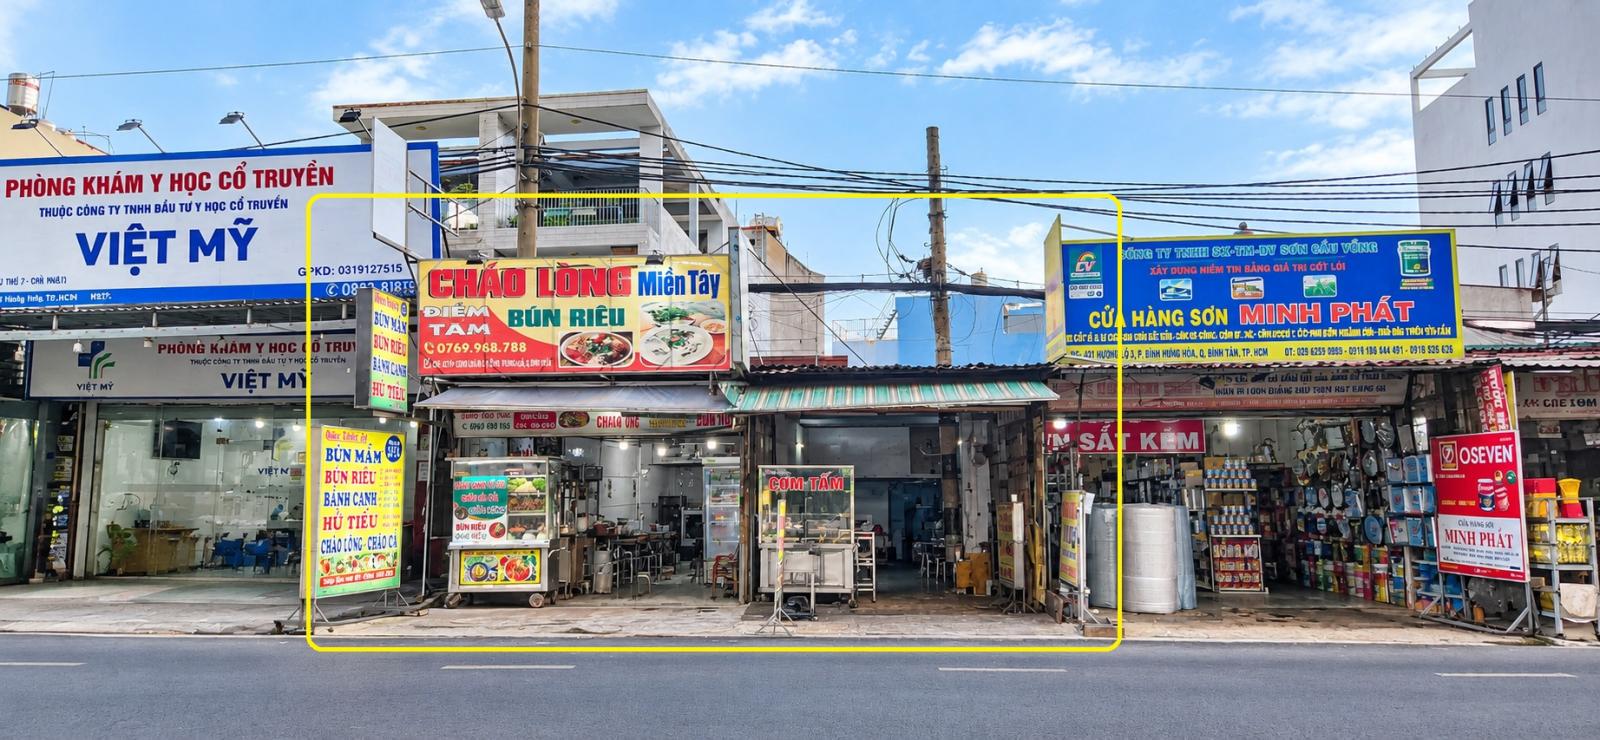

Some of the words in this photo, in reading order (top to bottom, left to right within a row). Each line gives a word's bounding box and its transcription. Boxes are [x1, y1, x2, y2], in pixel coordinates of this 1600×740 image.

[5, 174, 76, 198] PHÒNG
[83, 171, 143, 195] KHÁM
[151, 174, 163, 192] Y
[169, 172, 211, 196] HỌC
[219, 161, 247, 190] CỔ
[253, 160, 334, 189] TRUYỀN
[109, 205, 121, 215] TY
[125, 203, 151, 214] TNHH
[195, 202, 202, 212] Y
[205, 202, 226, 214] HỌC
[76, 223, 176, 276] VIỆT
[189, 217, 259, 262] MỸ
[1155, 247, 1172, 259] TY
[1174, 246, 1209, 258] TNHH
[338, 263, 402, 275] 0319127515
[1226, 264, 1242, 273] TIN
[428, 262, 526, 298] CHÁO
[536, 262, 632, 298] LÒNG
[638, 267, 686, 297] Miền
[688, 270, 721, 299] Tây
[423, 302, 491, 318] ĐIỂM
[508, 306, 561, 327] BÚN
[569, 304, 625, 327] RIÊU
[1132, 306, 1185, 328] HÀNG
[1190, 305, 1228, 325] SƠN
[1239, 302, 1322, 326] MINH
[1330, 296, 1415, 324] PHÁT
[255, 342, 264, 353] Y
[77, 382, 97, 391] VIỆT
[221, 369, 271, 394] VIỆT
[1080, 424, 1130, 450] SẮT
[325, 444, 351, 462] BÚN
[1460, 444, 1513, 464] OSEVEN
[325, 466, 348, 484] BÚN
[351, 466, 376, 484] RIÊU
[768, 476, 804, 491] CƠM
[809, 471, 845, 491] TẤM
[353, 492, 377, 506] CANH
[1445, 529, 1476, 546] MINH
[1479, 527, 1513, 549] PHÁT
